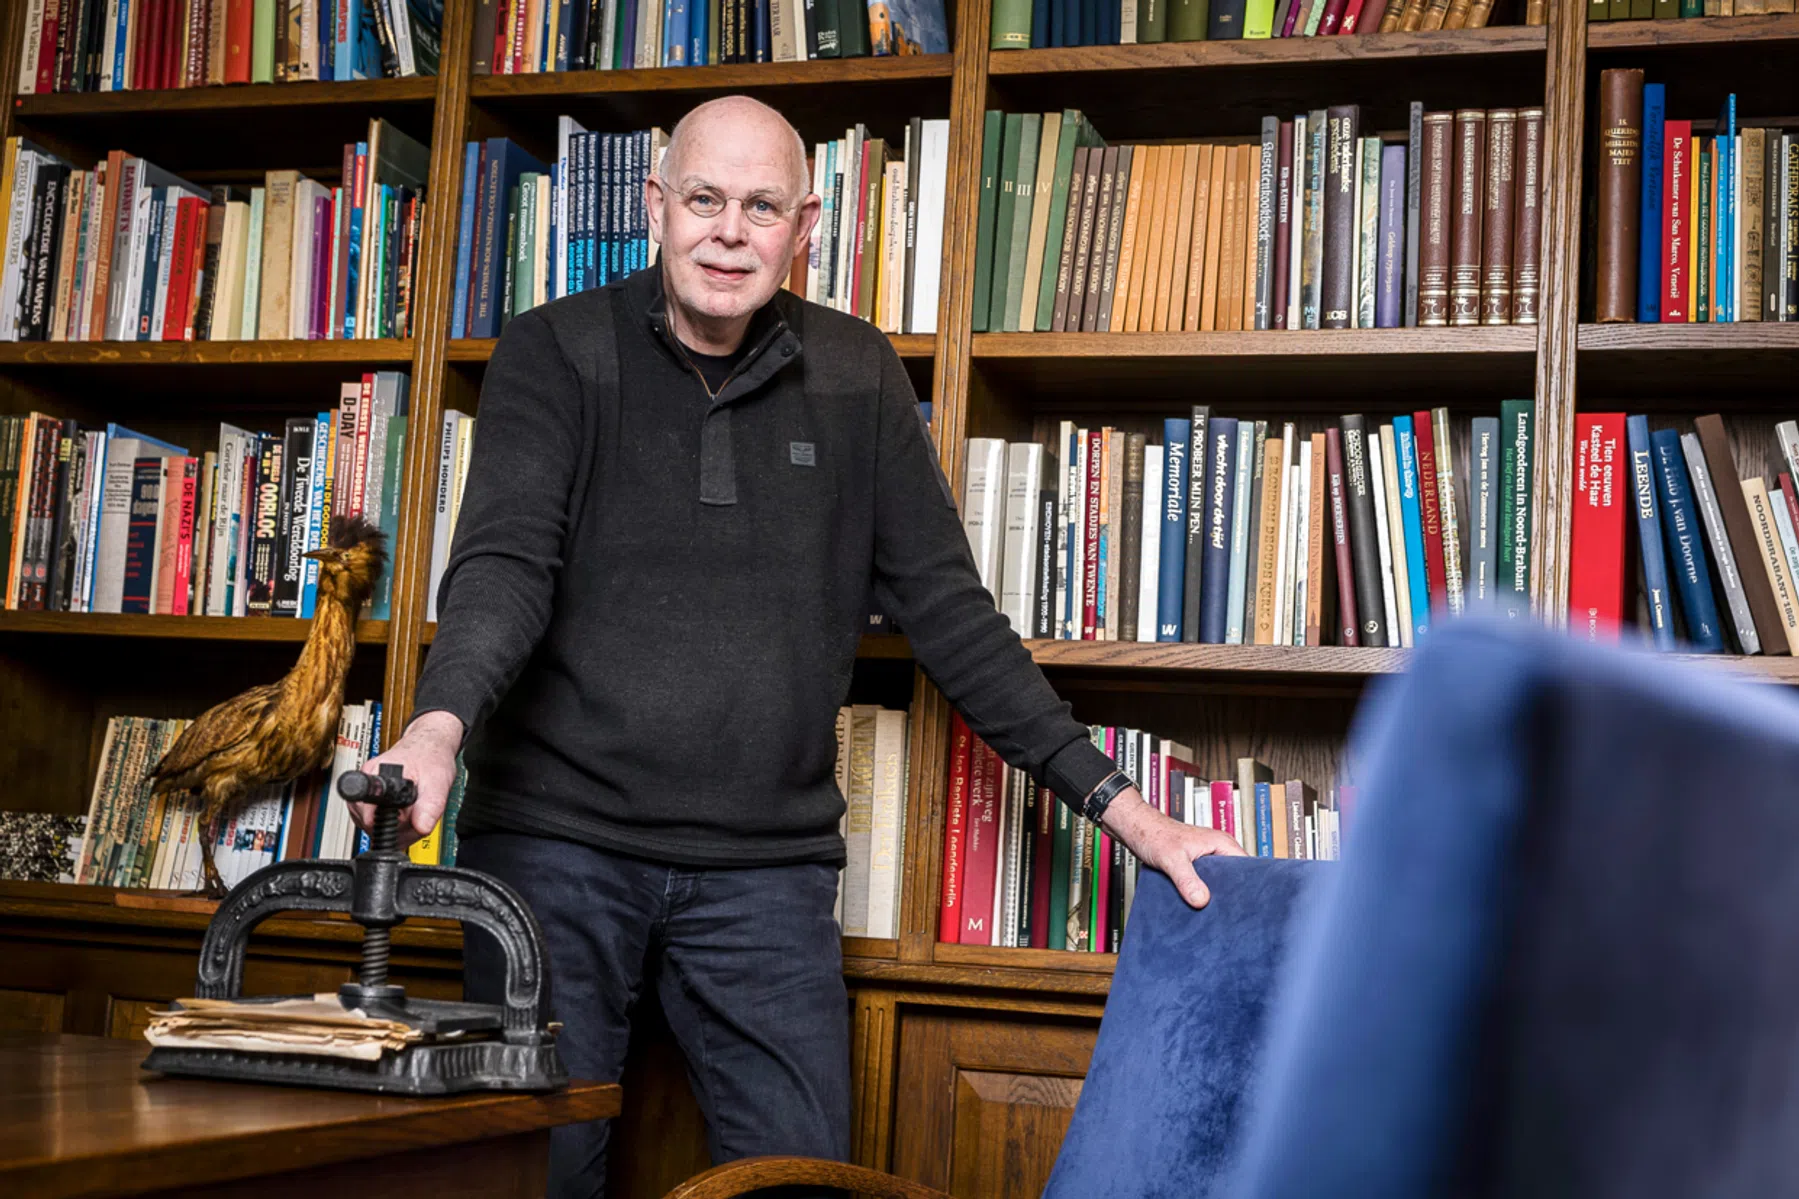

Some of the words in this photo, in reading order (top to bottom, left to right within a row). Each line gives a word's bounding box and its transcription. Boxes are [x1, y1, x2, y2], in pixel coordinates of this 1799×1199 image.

[1312, 132, 1320, 145] Het
[1342, 117, 1352, 140] onze
[1673, 137, 1683, 149] De
[578, 135, 586, 166] Meesters
[614, 136, 622, 169] Meesters
[625, 136, 633, 169] Meesters
[1329, 118, 1341, 174] geschiedenis
[18, 159, 30, 199] PISTOLS
[613, 171, 621, 184] der
[1340, 141, 1353, 192] vaderlandse
[1672, 150, 1683, 199] Schatkamer
[1788, 143, 1799, 218] CATHEDRALS
[521, 182, 530, 207] Groot
[1004, 181, 1013, 192] II
[1018, 184, 1031, 196] III
[1036, 182, 1050, 193] IV
[1058, 177, 1067, 188] V
[42, 181, 57, 254] ENCYCLOPEDIE
[613, 185, 621, 232] Schilderkunst
[1671, 201, 1682, 217] van
[10, 210, 23, 266] REVOLVERS
[518, 208, 528, 262] museumboek
[1061, 254, 1070, 263] EN
[1069, 193, 1078, 203] van
[1077, 256, 1086, 265] EN
[1085, 195, 1094, 205] van
[1093, 255, 1101, 264] EN
[1100, 193, 1109, 204] van
[1106, 253, 1115, 262] EN
[1114, 191, 1123, 202] van
[1671, 219, 1681, 235] San
[576, 240, 584, 266] Pieter
[612, 241, 620, 272] Picasso
[1387, 231, 1396, 258] Geldrop
[38, 256, 49, 279] VAN
[1670, 267, 1680, 298] Venetië
[31, 281, 46, 326] WAPENS
[479, 302, 488, 318] THE
[363, 382, 371, 395] DE
[340, 397, 357, 439] D-DAY
[359, 397, 370, 433] EERSTE
[1194, 414, 1205, 427] IK
[314, 422, 329, 487] GESCHIEDENIS
[442, 422, 453, 462] PHILIPS
[1091, 437, 1101, 478] DORPEN
[1191, 428, 1204, 478] PROBEER
[1216, 433, 1229, 475] vlucht
[1480, 432, 1490, 457] Hertog
[1515, 411, 1528, 491] Landgoederen
[1590, 424, 1604, 465] Kasteel
[1605, 438, 1616, 462] Tien
[1659, 446, 1673, 464] Dr.
[224, 442, 234, 479] Corridor
[297, 458, 311, 473] De
[352, 434, 367, 514] WERELDOORLOG
[1480, 471, 1488, 480] en
[1589, 466, 1601, 478] de
[181, 481, 194, 498] DE
[222, 482, 230, 503] naar
[294, 476, 309, 512] Tweede
[323, 491, 333, 503] DE
[324, 479, 333, 489] IN
[438, 464, 450, 513] HONDERD
[1090, 480, 1100, 495] EN
[1167, 441, 1185, 522] Memoriale
[1190, 481, 1202, 509] MIJN
[1214, 476, 1226, 507] door
[1421, 451, 1438, 535] NEDERLAND
[1480, 481, 1489, 491] de
[1588, 480, 1601, 507] Haar
[1602, 465, 1613, 507] eeuwen
[1633, 450, 1654, 519] LEENDE
[221, 506, 229, 516] de
[257, 483, 278, 539] OORLOG
[313, 489, 324, 507] VAN
[1516, 493, 1527, 505] in
[1669, 497, 1683, 508] J.
[180, 500, 192, 540] NAZI'S
[217, 517, 228, 538] Rijn
[311, 509, 323, 527] HET
[1044, 501, 1053, 541] EINDHOVEN
[1088, 497, 1100, 539] STADJES
[1188, 511, 1201, 545] PEN...
[1213, 508, 1224, 524] de
[1673, 508, 1687, 532] van
[284, 514, 306, 582] Wereldoorlog
[1087, 541, 1098, 561] VAN
[1211, 525, 1225, 549] tijd
[1514, 507, 1527, 592] Noord-Brabant
[306, 564, 319, 585] RIJK
[1678, 534, 1698, 584] Doorne
[1753, 494, 1788, 598] NOORDBRABANT
[1782, 601, 1796, 628] 1865
[1085, 563, 1097, 607] TWENTE
[972, 738, 984, 777] mplete
[985, 759, 994, 773] en
[876, 752, 898, 830] Erdkreis
[972, 779, 981, 806] werk
[983, 776, 994, 798] zijn
[981, 800, 993, 823] weg
[873, 834, 894, 871] Der
[968, 917, 983, 931] M
